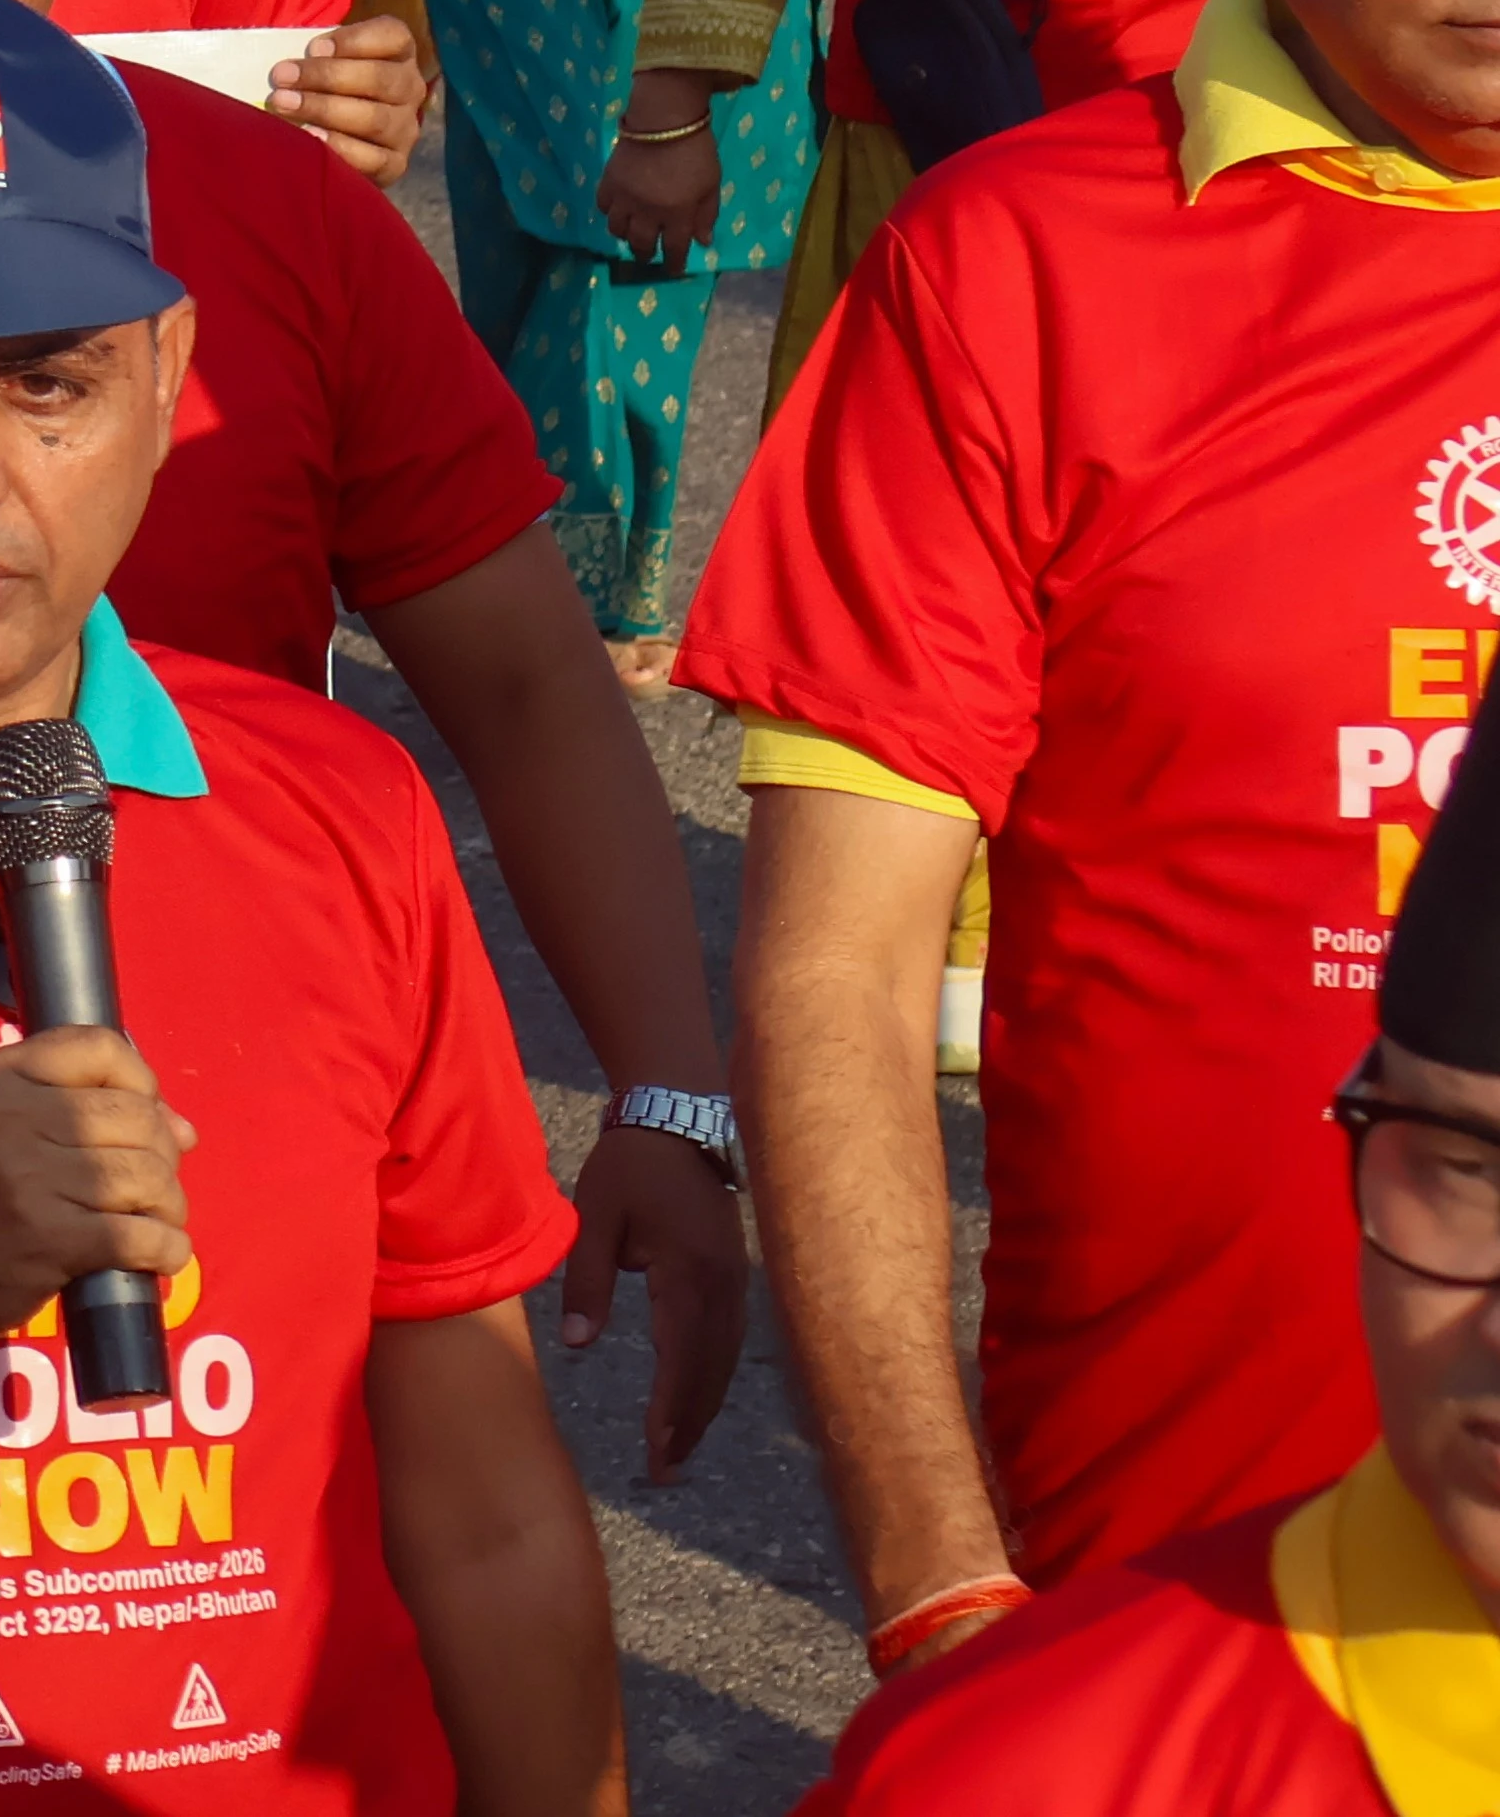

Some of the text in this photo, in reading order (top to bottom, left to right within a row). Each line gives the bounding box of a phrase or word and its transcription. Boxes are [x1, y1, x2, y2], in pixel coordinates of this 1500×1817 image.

[220, 1549, 266, 1579] 2026
[34, 1603, 110, 1635] 3292,
[116, 1586, 276, 1631] Nepal-Bhutan
